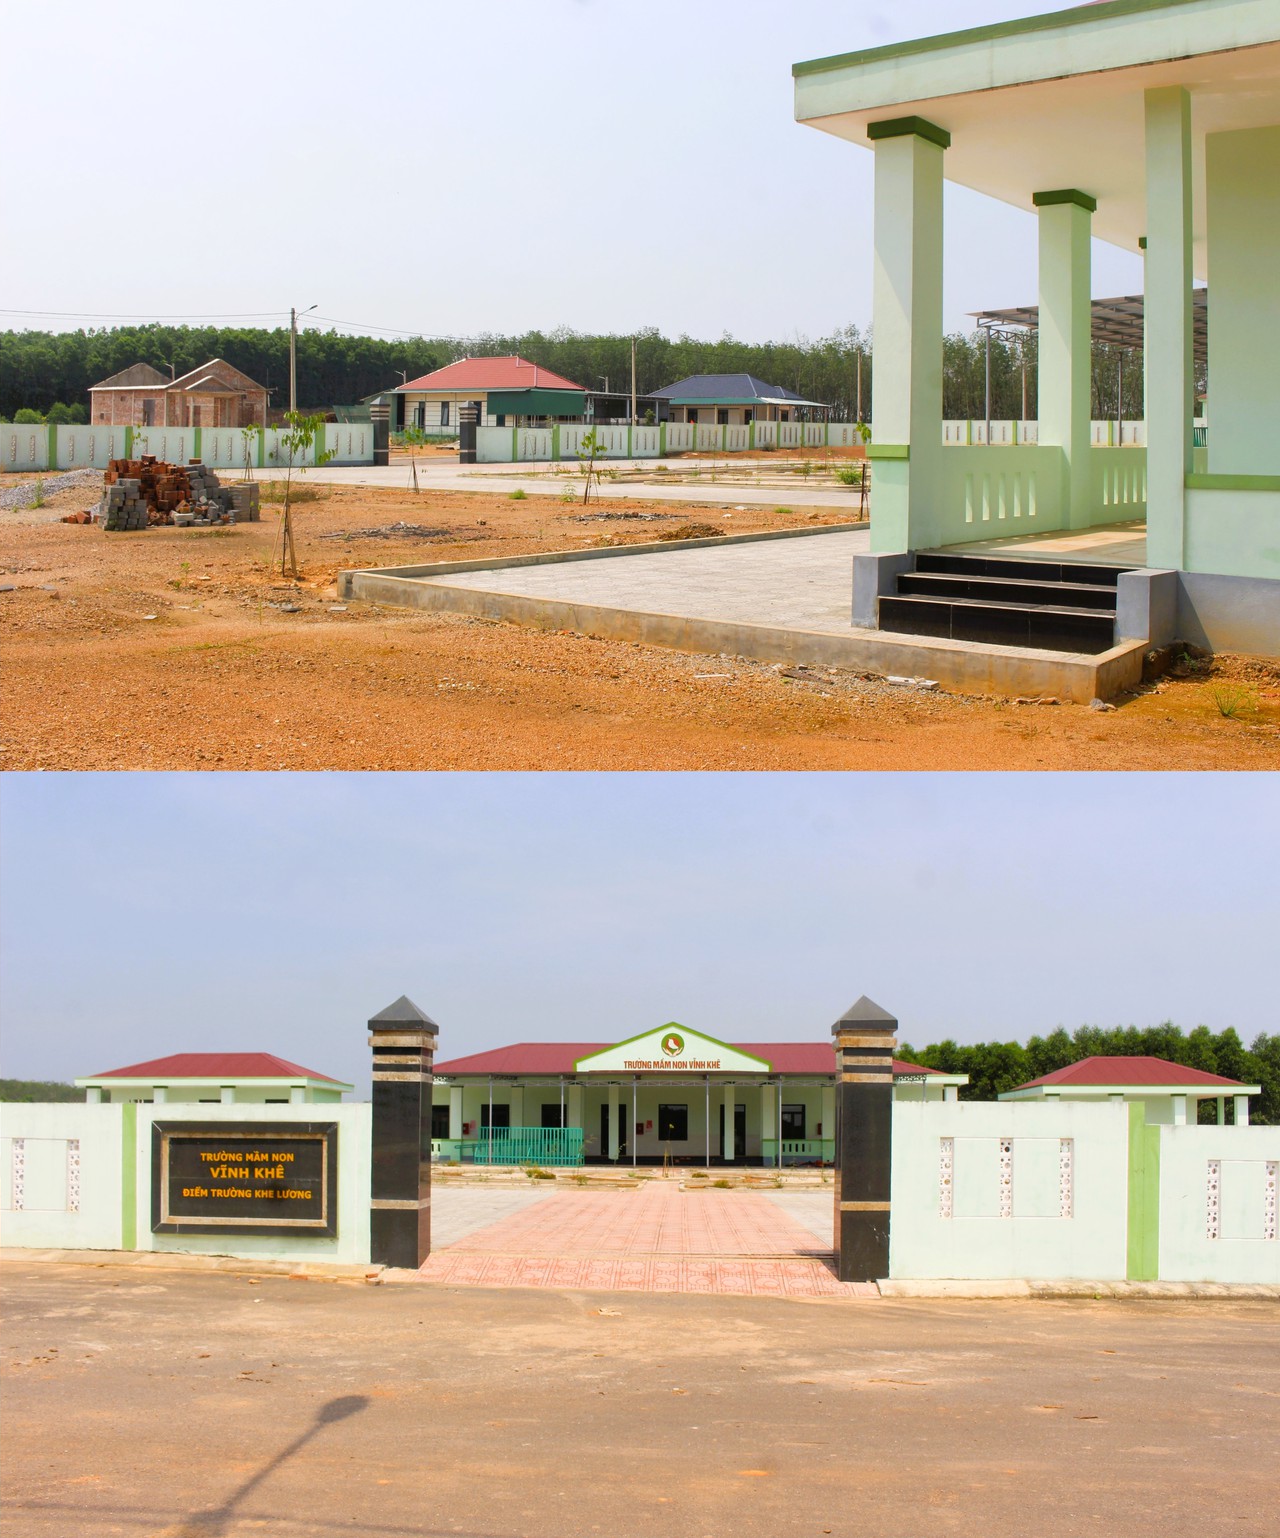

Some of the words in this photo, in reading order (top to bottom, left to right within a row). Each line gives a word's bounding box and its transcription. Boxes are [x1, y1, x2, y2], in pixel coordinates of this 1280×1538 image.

[672, 1060, 687, 1069] NON
[200, 1150, 242, 1162] TRƯỜNG
[272, 1152, 294, 1162] NON
[210, 1164, 249, 1179] VĨNH
[254, 1164, 284, 1179] KHÊ
[210, 1187, 252, 1198] TRƯỜNG
[255, 1189, 274, 1199] KHE
[277, 1189, 312, 1199] LƯƠNG
